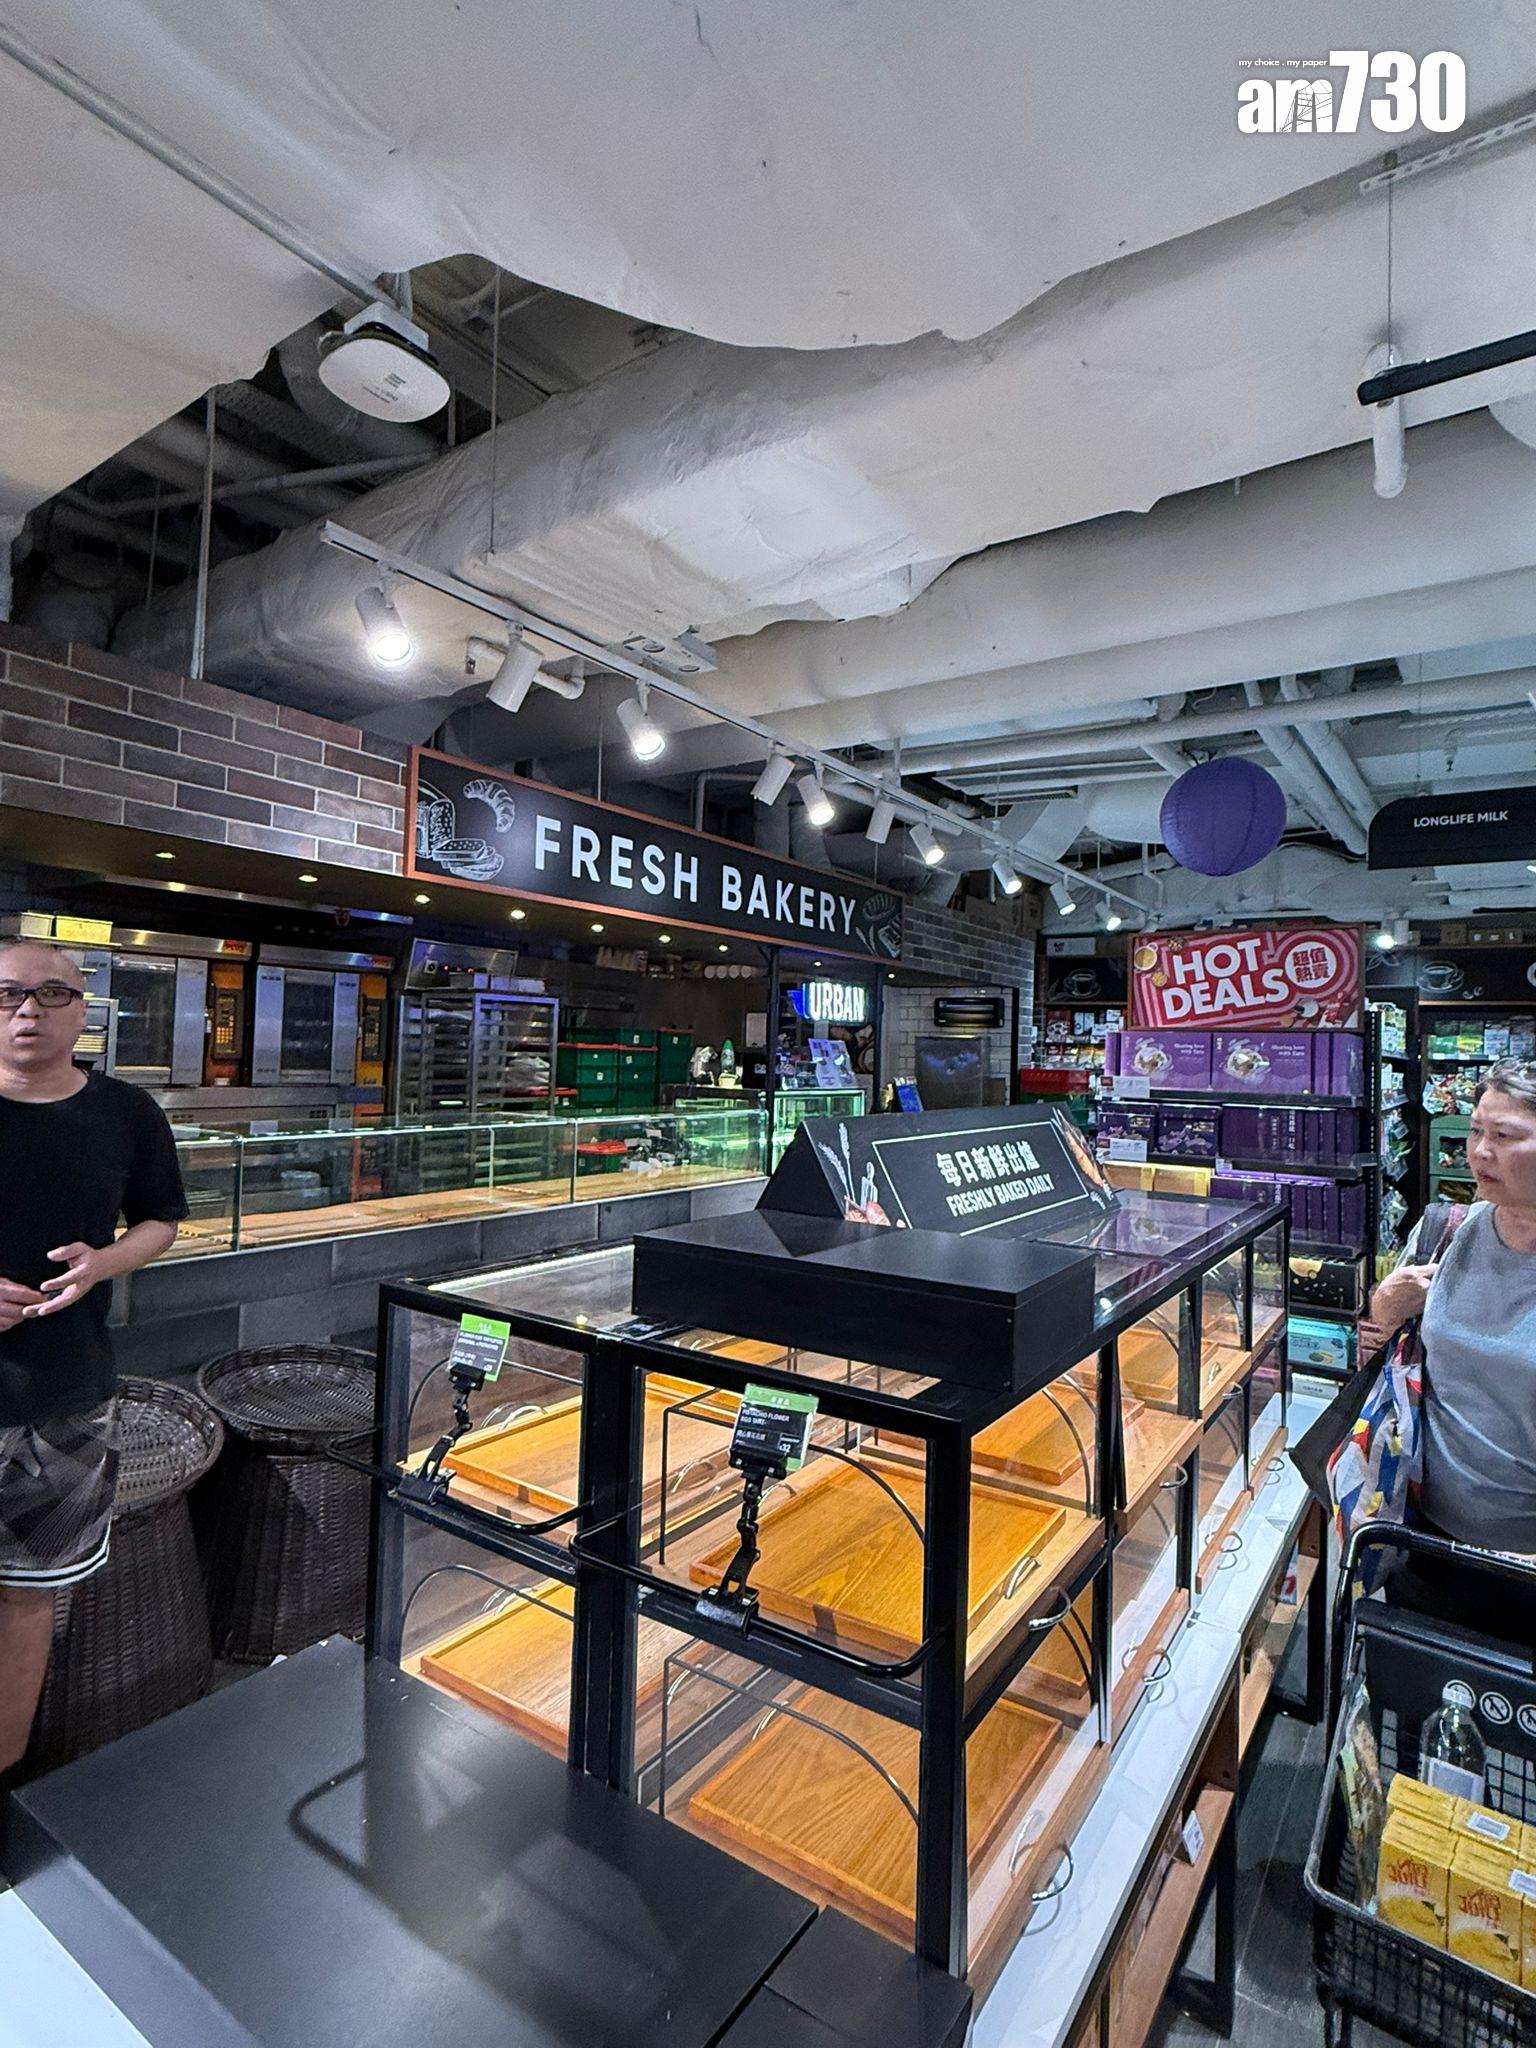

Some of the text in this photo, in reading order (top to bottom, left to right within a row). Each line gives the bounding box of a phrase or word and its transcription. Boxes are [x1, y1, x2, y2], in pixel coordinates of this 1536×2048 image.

[1413, 810, 1509, 828] LONGLIFE MILK
[534, 814, 857, 936] FRESH BAKERY
[1172, 938, 1261, 985] HOT
[1292, 947, 1327, 966] 超值
[809, 981, 865, 1022] URBAN
[1162, 968, 1290, 1019] DEALS
[936, 1140, 1041, 1187] 每日新鮮出爐
[945, 1173, 1055, 1217] FRESHLY BAKED DAILY
